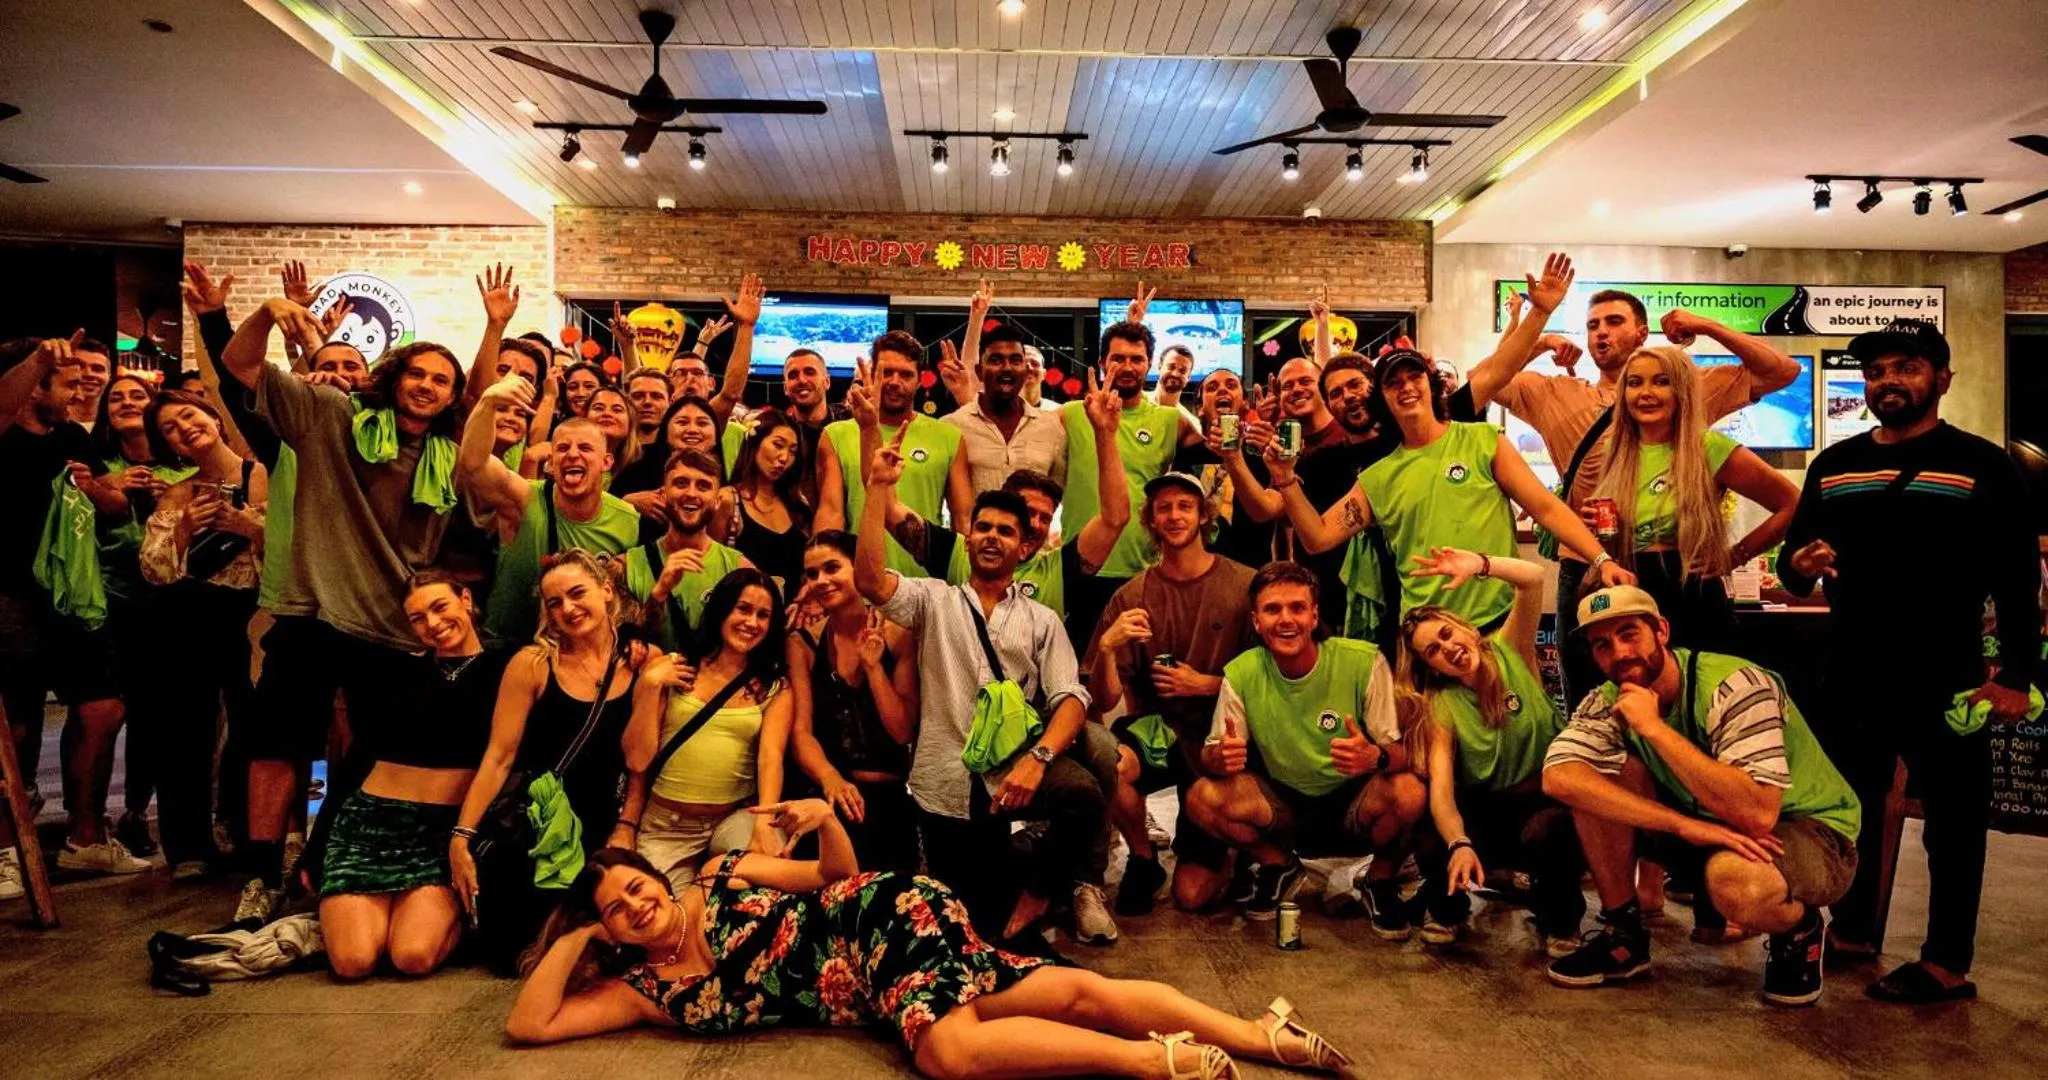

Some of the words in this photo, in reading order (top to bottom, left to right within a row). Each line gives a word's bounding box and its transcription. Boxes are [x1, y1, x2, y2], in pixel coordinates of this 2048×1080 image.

[806, 235, 928, 267] HAPPY
[971, 242, 1049, 270] NEW
[1094, 242, 1192, 270] YEAR
[312, 288, 337, 315] MAD
[348, 282, 403, 314] MONKEY
[1658, 290, 1766, 308] information
[1813, 296, 1831, 307] an
[1835, 295, 1865, 309] epic
[1867, 295, 1923, 309] journey
[1927, 295, 1939, 307] is
[1829, 314, 1871, 326] about
[1875, 315, 1890, 326] to
[2012, 737, 2040, 751] Rolls
